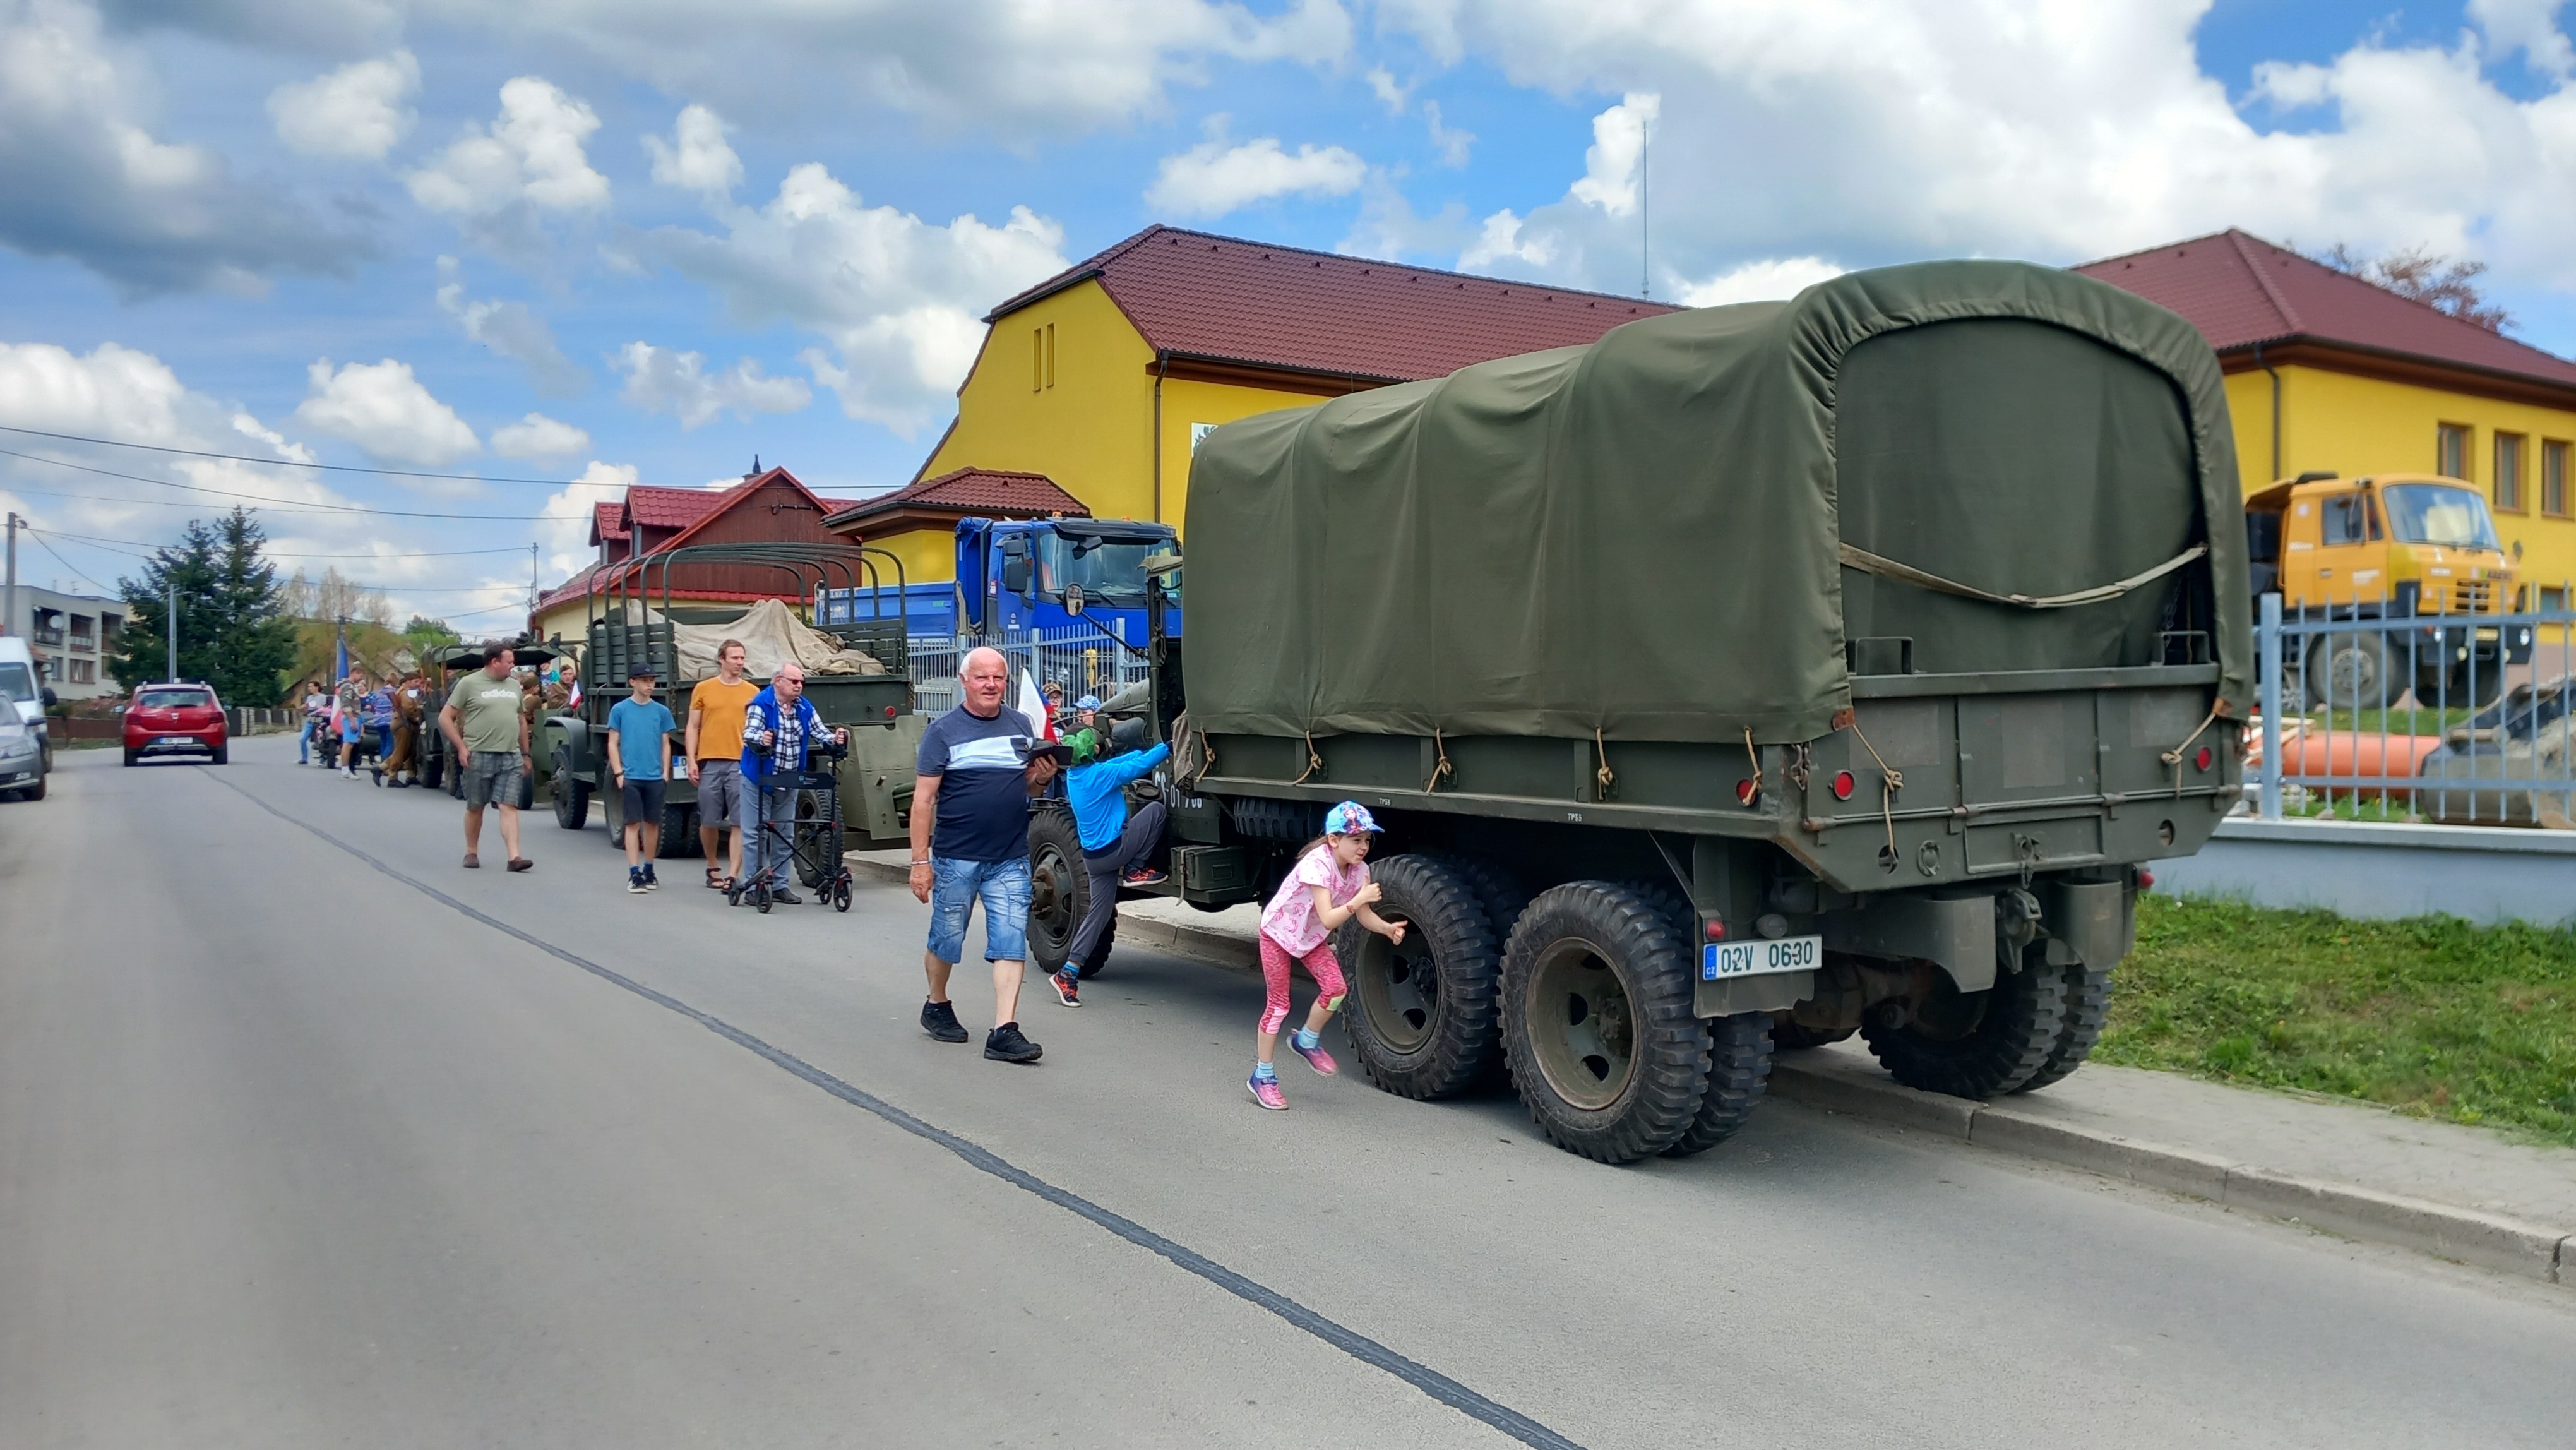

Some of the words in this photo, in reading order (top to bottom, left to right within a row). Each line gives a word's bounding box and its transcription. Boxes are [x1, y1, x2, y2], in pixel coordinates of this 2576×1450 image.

[1721, 945, 1754, 974] 02V
[1769, 940, 1813, 968] 0630
[1706, 966, 1716, 975] CZ
